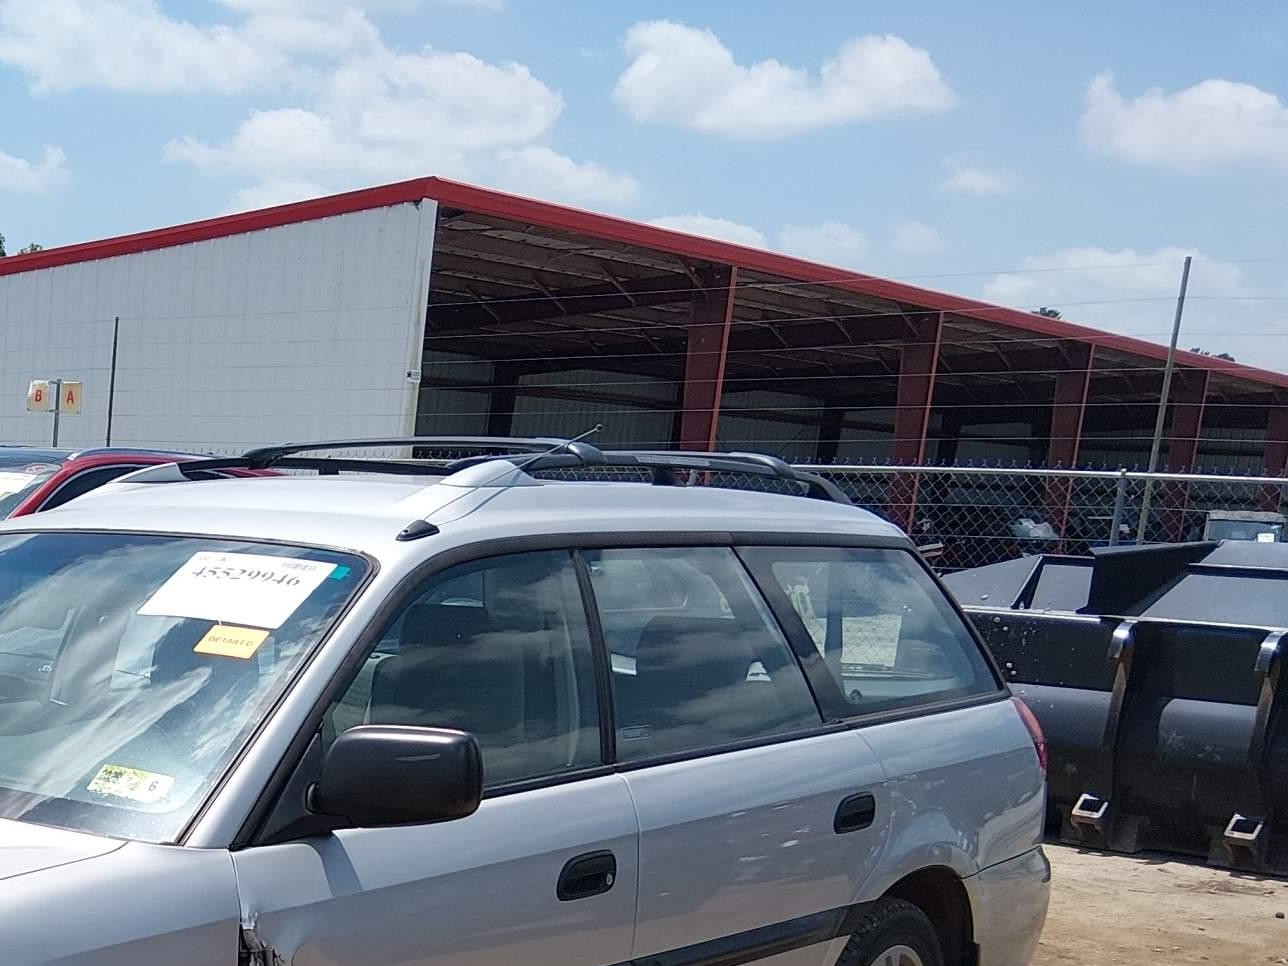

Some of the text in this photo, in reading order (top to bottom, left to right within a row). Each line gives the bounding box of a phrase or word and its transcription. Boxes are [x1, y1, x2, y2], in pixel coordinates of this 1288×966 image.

[34, 389, 42, 402] B
[67, 390, 74, 404] A
[192, 566, 301, 587] 45529946
[148, 780, 160, 792] 6
